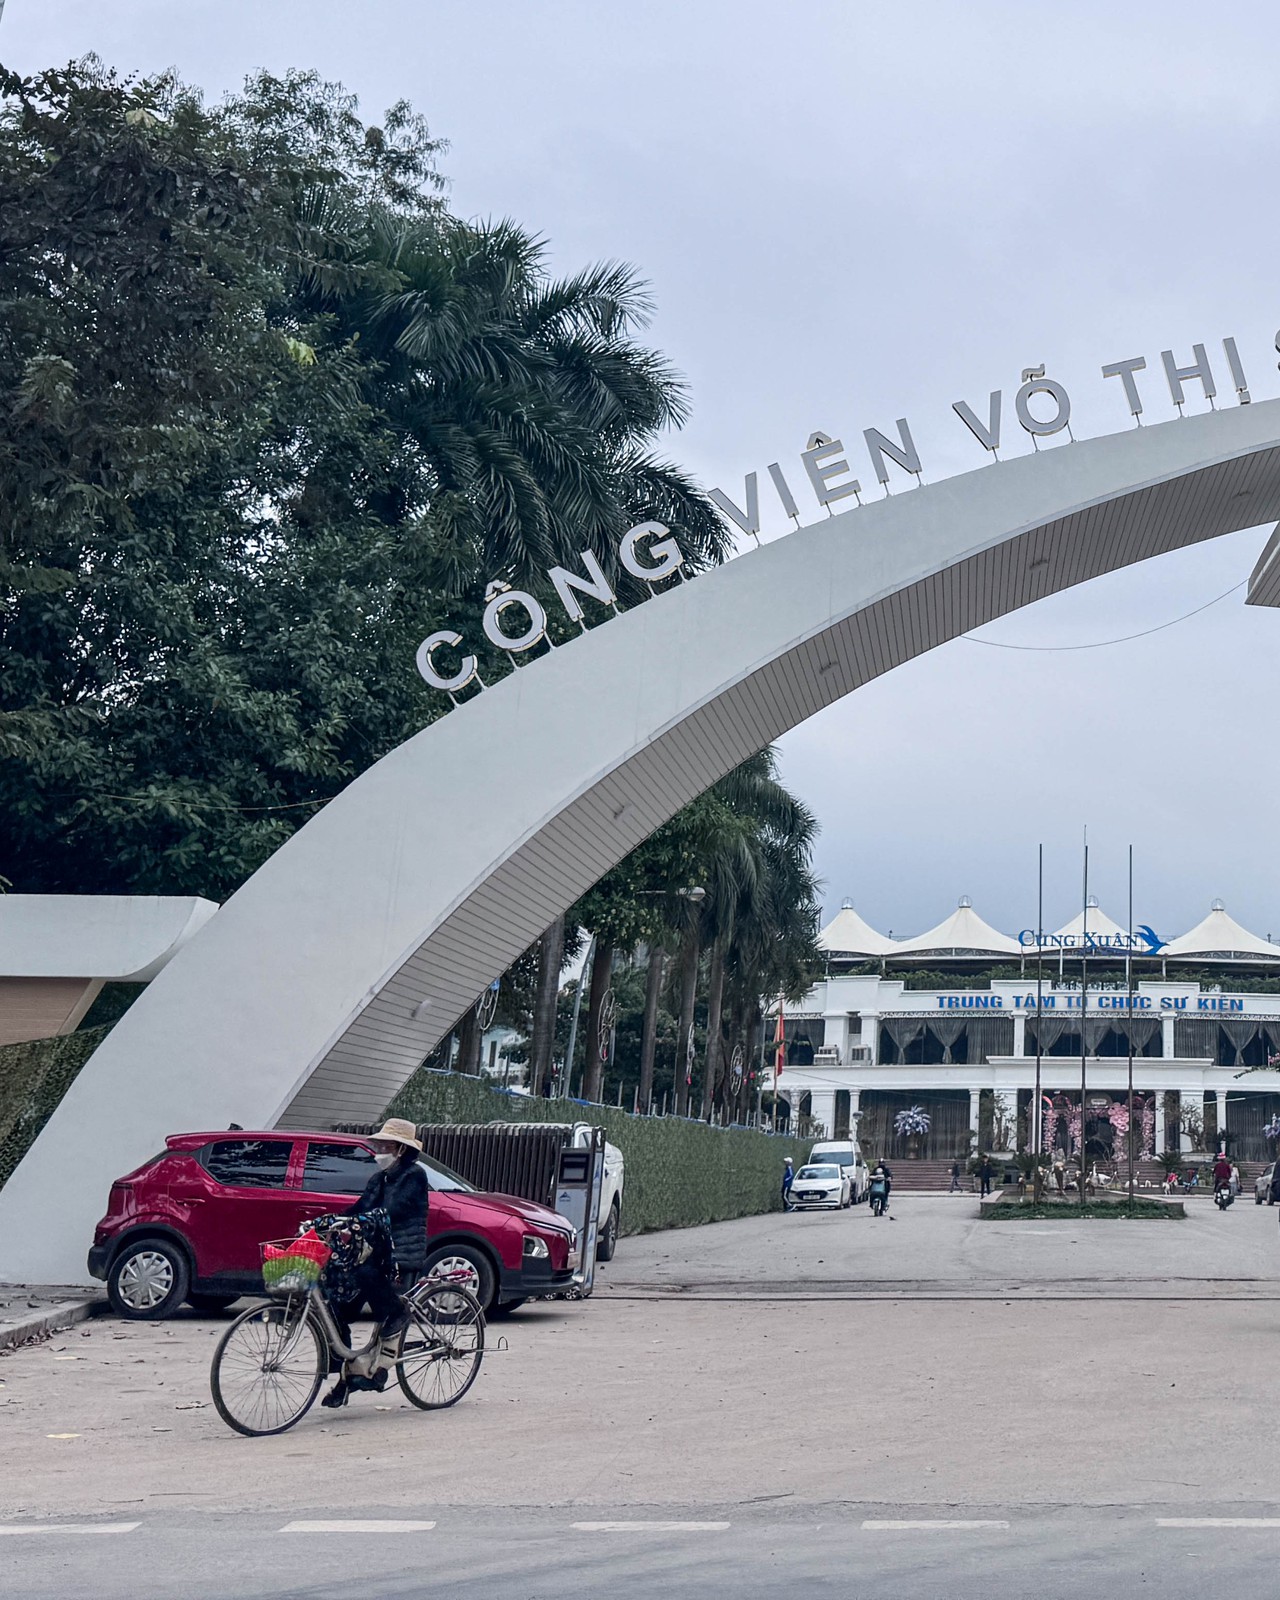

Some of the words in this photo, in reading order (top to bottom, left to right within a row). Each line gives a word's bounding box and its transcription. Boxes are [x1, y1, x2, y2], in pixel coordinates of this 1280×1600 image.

[416, 520, 684, 692] CÔNG
[707, 418, 923, 536] VIÊN
[952, 363, 1071, 452] VÕ
[1101, 336, 1252, 405] THỊ
[936, 995, 1003, 1009] TRUNG
[1012, 993, 1056, 1009] TÂM
